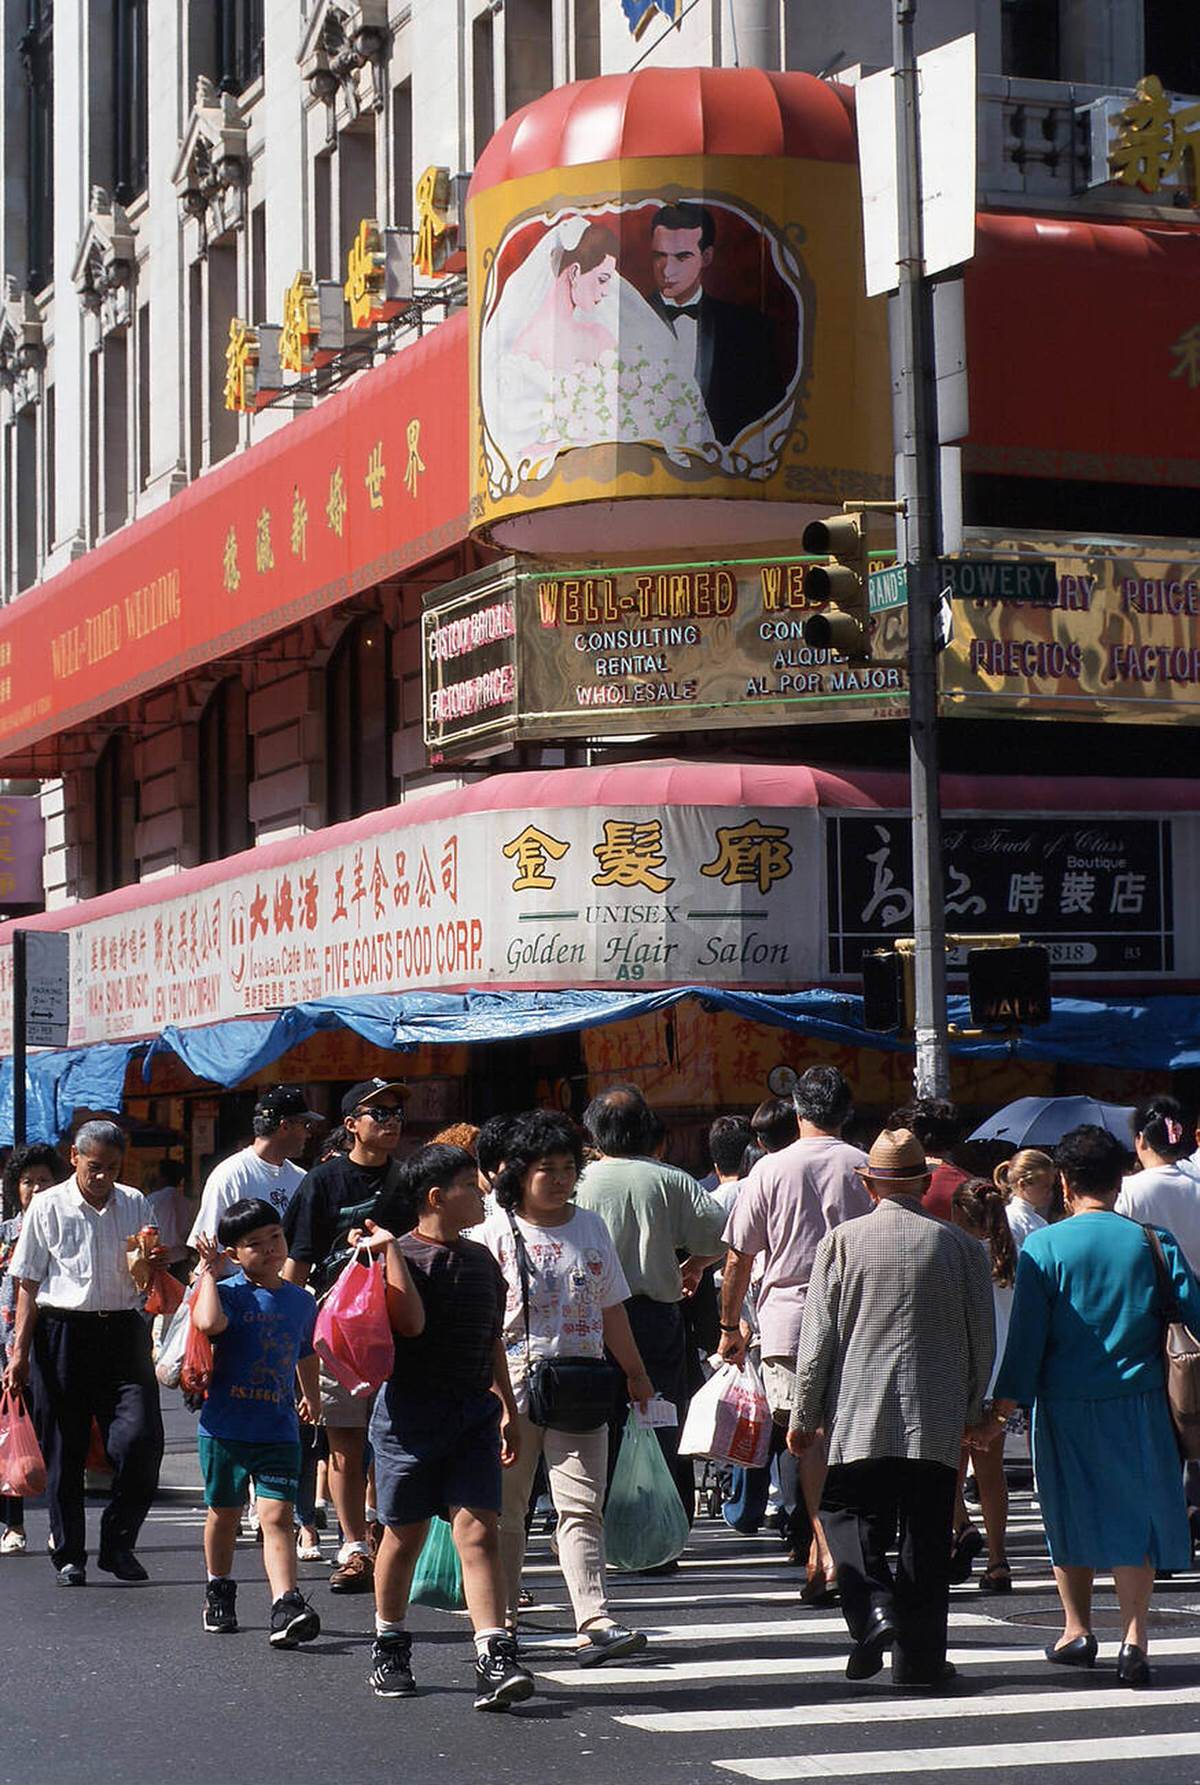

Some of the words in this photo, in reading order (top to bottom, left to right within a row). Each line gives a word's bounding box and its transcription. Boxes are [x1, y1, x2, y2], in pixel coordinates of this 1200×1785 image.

[869, 573, 897, 607] RAND
[943, 563, 1049, 595] BOWERY
[539, 573, 736, 625] WELL-TIMED
[575, 626, 697, 651] CONSULTING
[597, 657, 668, 675] RENTAL
[972, 639, 1081, 679] PRECIOS
[576, 680, 696, 705] WHOLESALE
[746, 676, 769, 695] AL
[830, 669, 899, 691] MAJOR
[502, 818, 793, 895] 金髮廊
[1067, 855, 1128, 871] Boutique
[332, 834, 458, 928] 五羊食品公司
[586, 905, 680, 924] UNISEX
[282, 945, 301, 975] Cafe
[325, 943, 349, 991] FIVE
[353, 931, 392, 986] GOATS
[396, 926, 432, 978] FOOD
[436, 919, 482, 975] CORP.
[506, 932, 585, 973] Golden
[603, 929, 679, 964] Hair
[697, 932, 790, 965] Salon
[615, 963, 645, 980] A9
